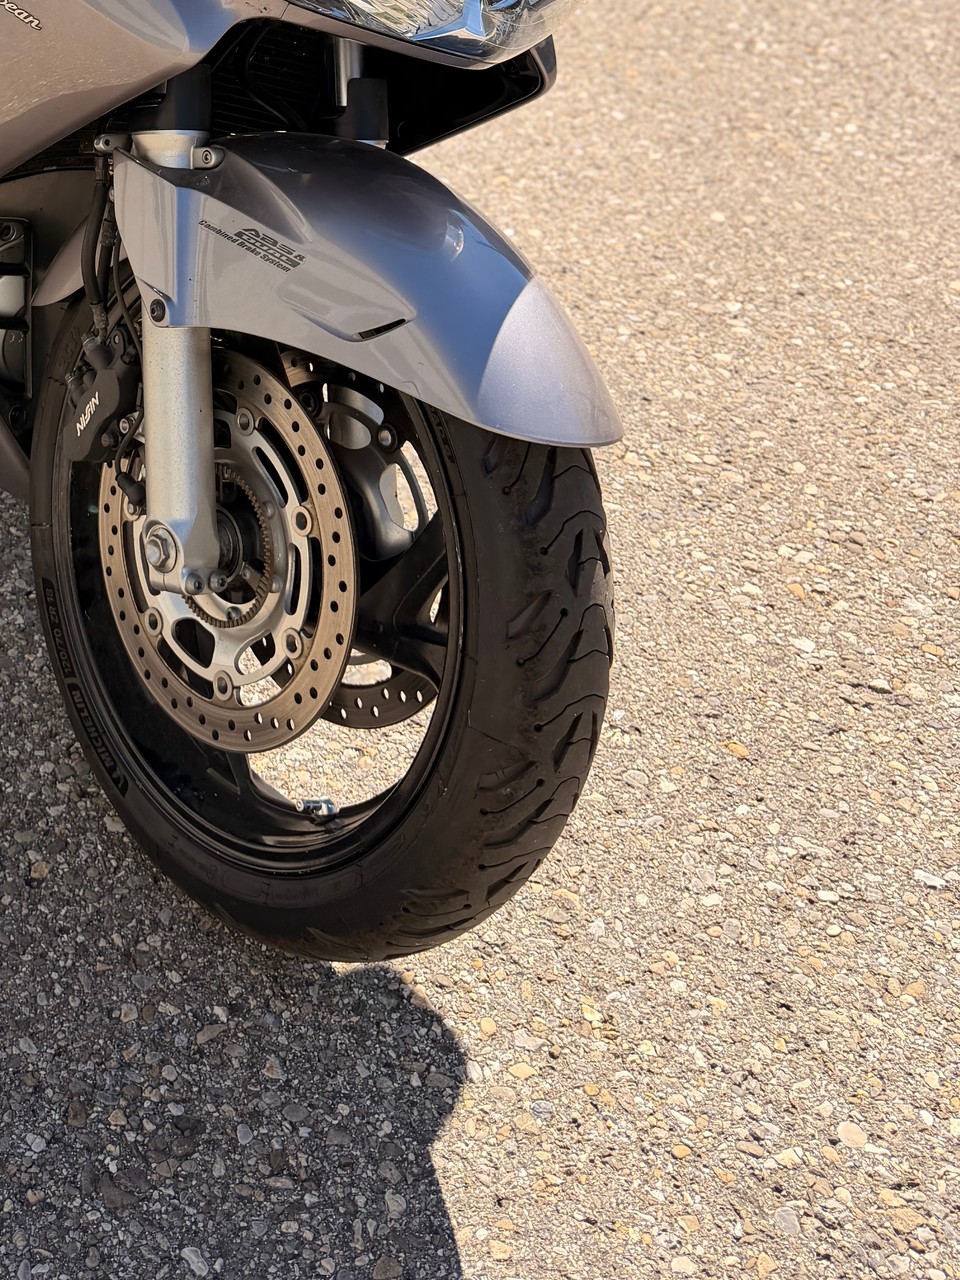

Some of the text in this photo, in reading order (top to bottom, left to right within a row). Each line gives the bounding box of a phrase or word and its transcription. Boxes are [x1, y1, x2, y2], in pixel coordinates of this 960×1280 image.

[198, 220, 292, 273] Combined Brake System
[241, 227, 296, 256] ABS
[48, 605, 59, 624] ZR
[53, 627, 72, 673] 120/70
[71, 689, 117, 770] MICHELIN
